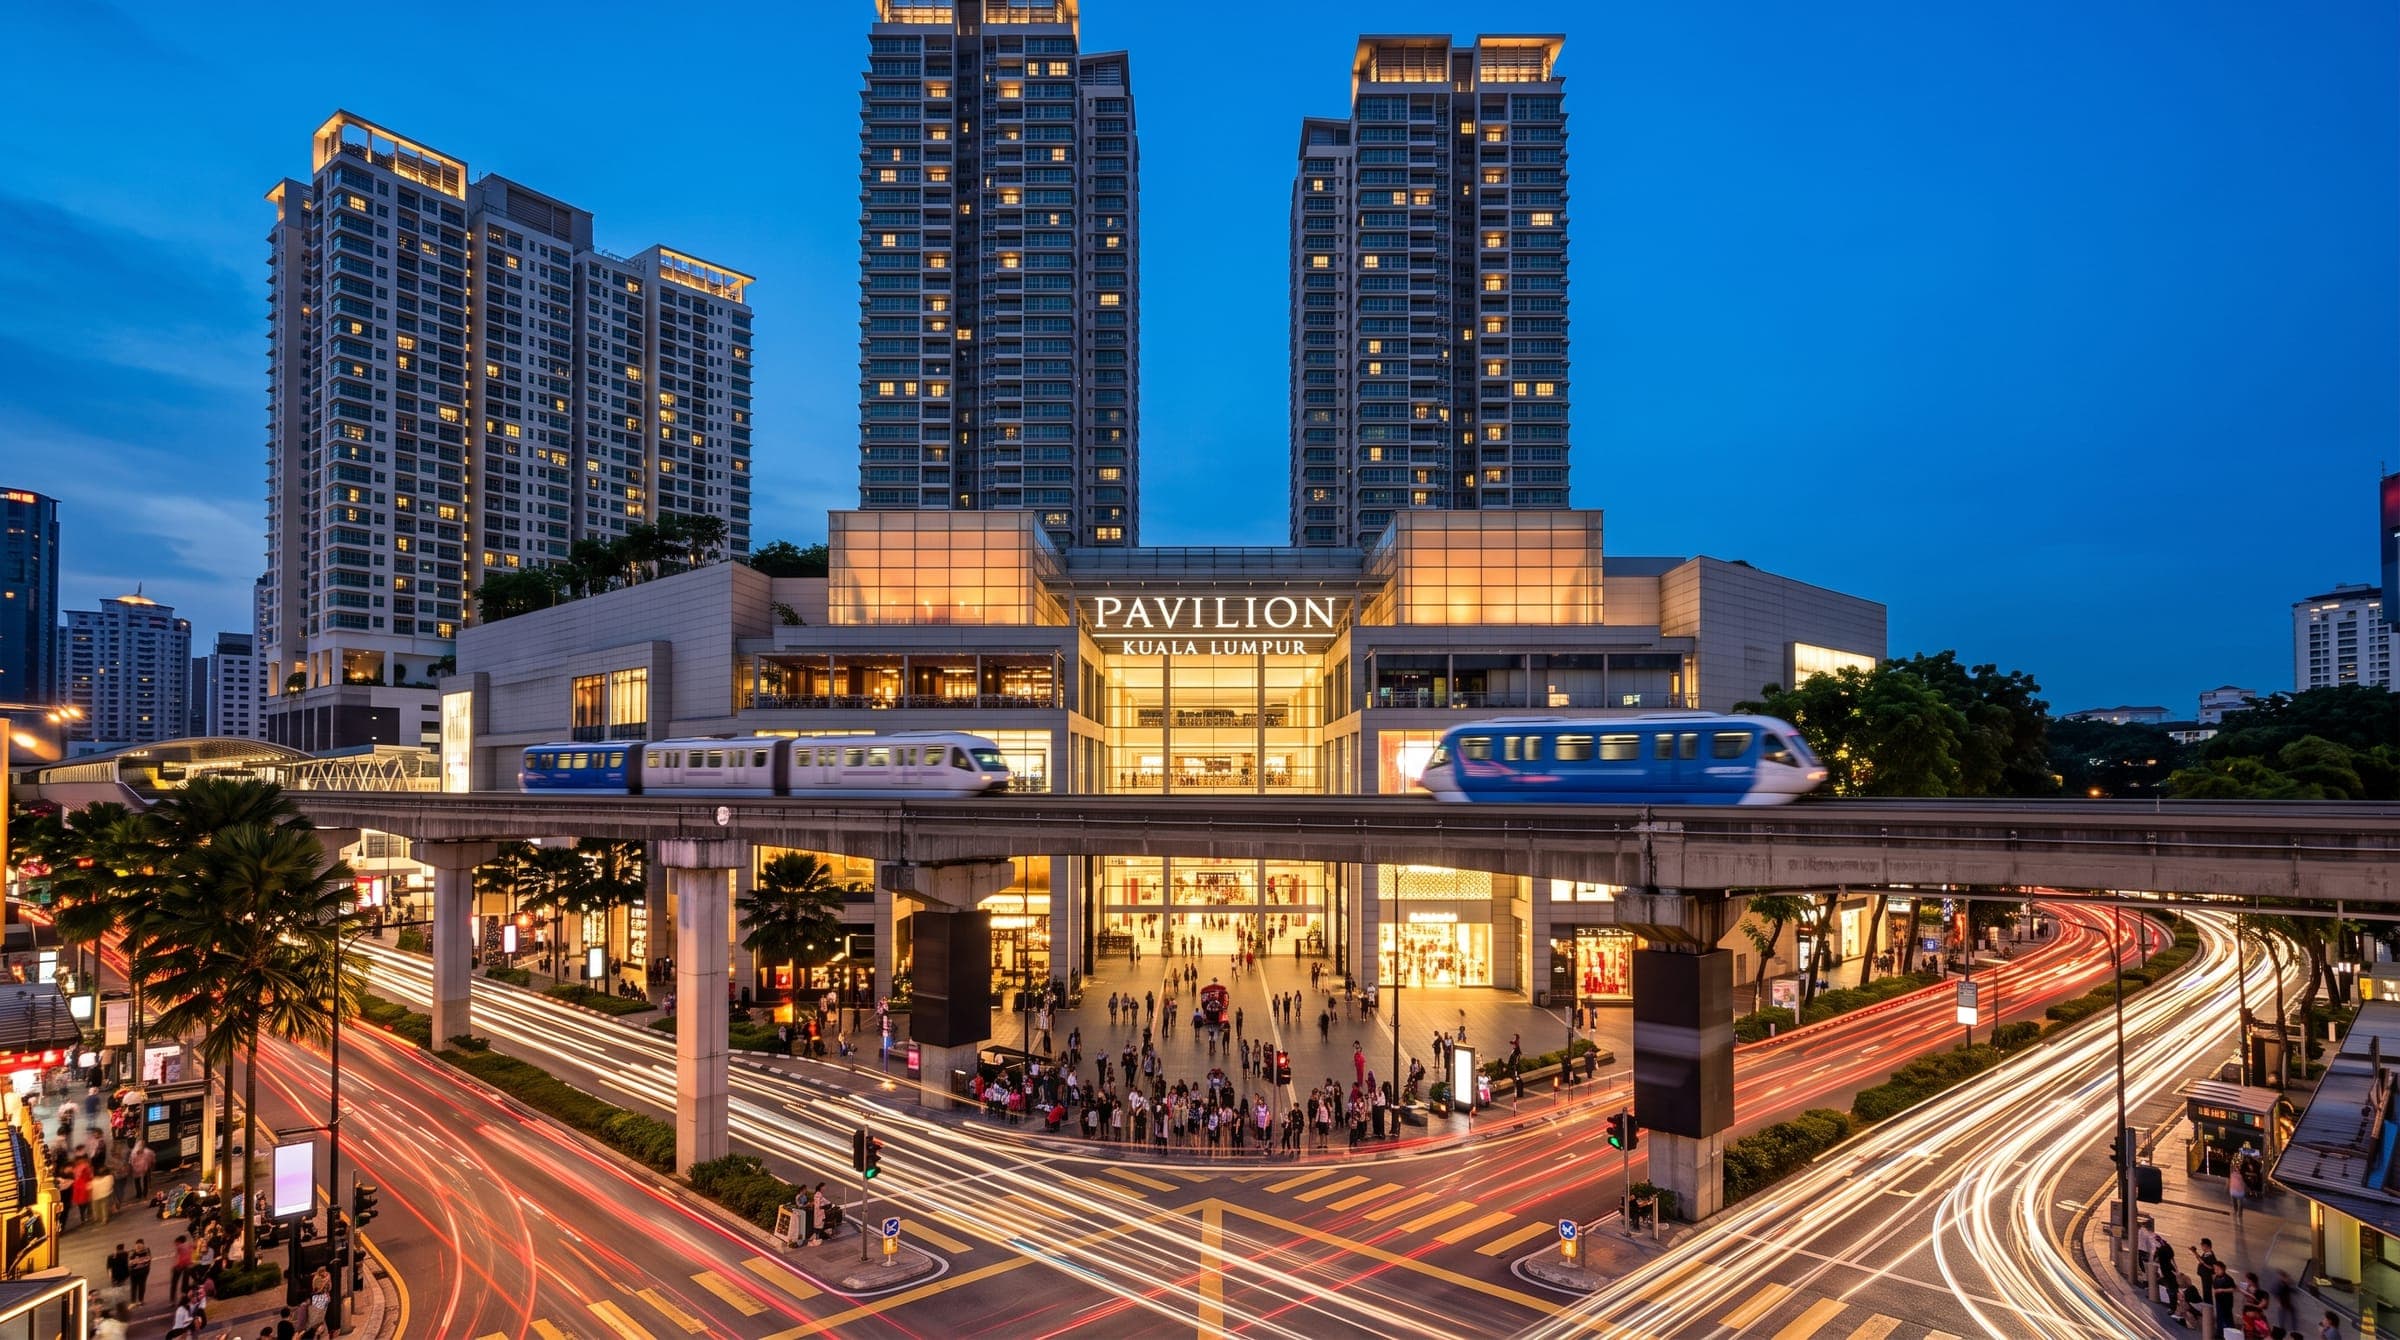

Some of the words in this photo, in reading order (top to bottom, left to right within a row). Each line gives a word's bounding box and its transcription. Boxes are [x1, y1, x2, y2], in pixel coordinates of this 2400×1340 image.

[1094, 596, 1336, 629] PAVILION
[1123, 640, 1198, 655] KUALA
[1211, 640, 1307, 655] LUMPUR
